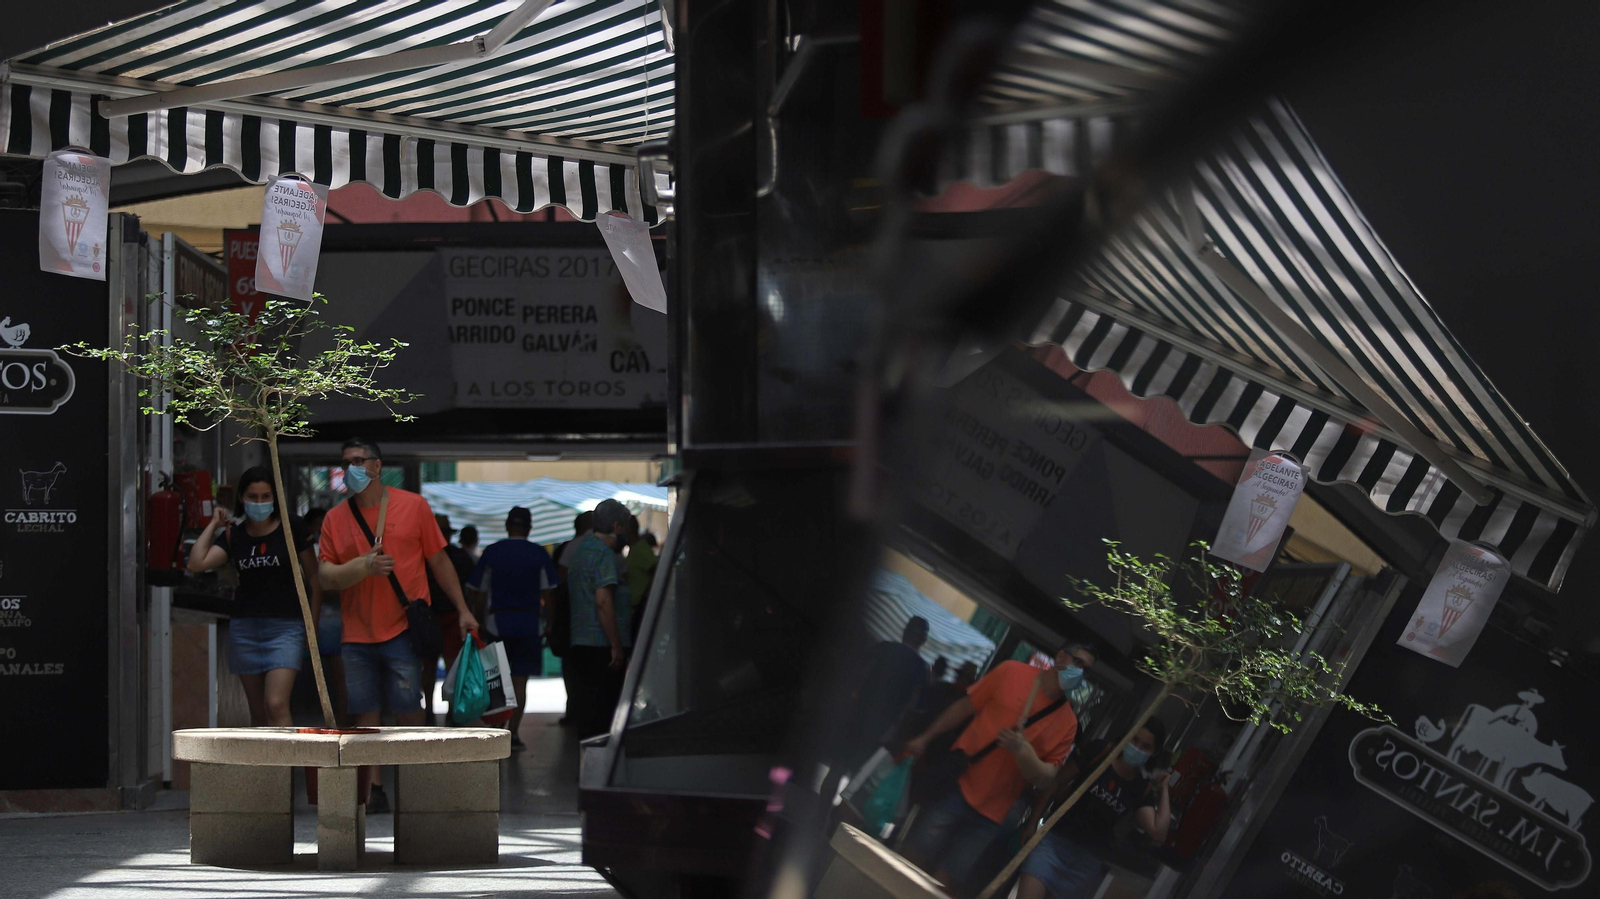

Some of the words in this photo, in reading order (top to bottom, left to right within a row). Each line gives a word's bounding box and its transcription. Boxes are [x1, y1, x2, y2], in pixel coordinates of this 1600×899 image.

[452, 298, 516, 317] PONCE
[522, 305, 598, 323] PERERA
[522, 330, 598, 352] GALVÁN
[468, 382, 482, 397] A
[491, 381, 536, 397] LOS
[544, 381, 626, 397] TOROS
[1252, 470, 1298, 490] ALGECIRAS!
[4, 512, 77, 523] CABRITO
[17, 524, 65, 533] LECHAL
[239, 555, 281, 571] KAFKA
